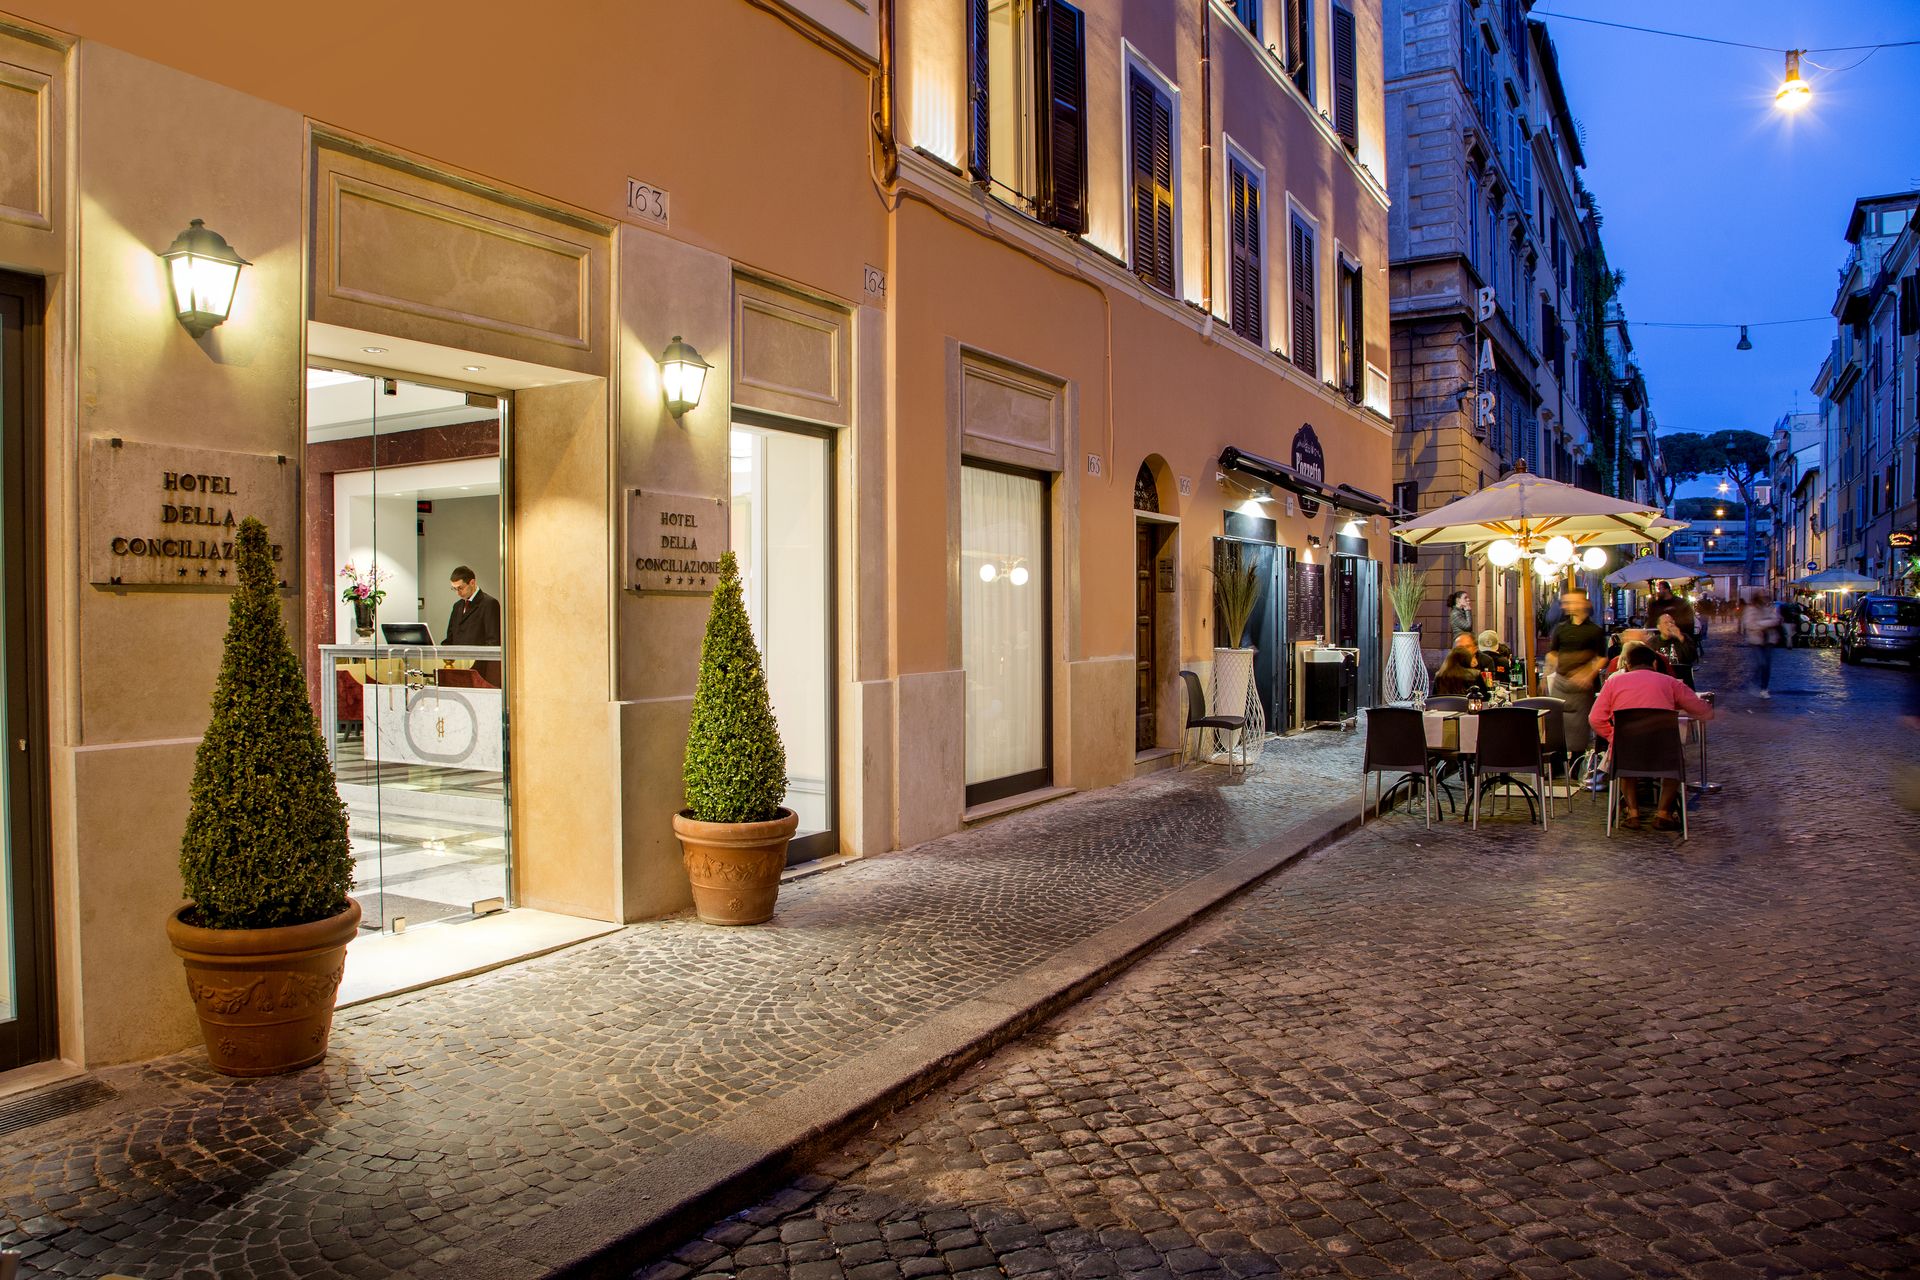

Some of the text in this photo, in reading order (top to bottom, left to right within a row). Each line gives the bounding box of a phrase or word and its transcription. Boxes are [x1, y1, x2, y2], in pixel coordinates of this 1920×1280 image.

[864, 268, 887, 297] 164
[1478, 285, 1497, 427] BAR
[1087, 455, 1101, 474] 165
[163, 471, 238, 496] HOTEL
[161, 504, 237, 528] DELLA
[660, 511, 699, 528] HOTEL
[111, 536, 284, 563] CONCILIAZE
[660, 535, 698, 551] DELLA
[635, 557, 721, 574] CONCILIAZIONE
